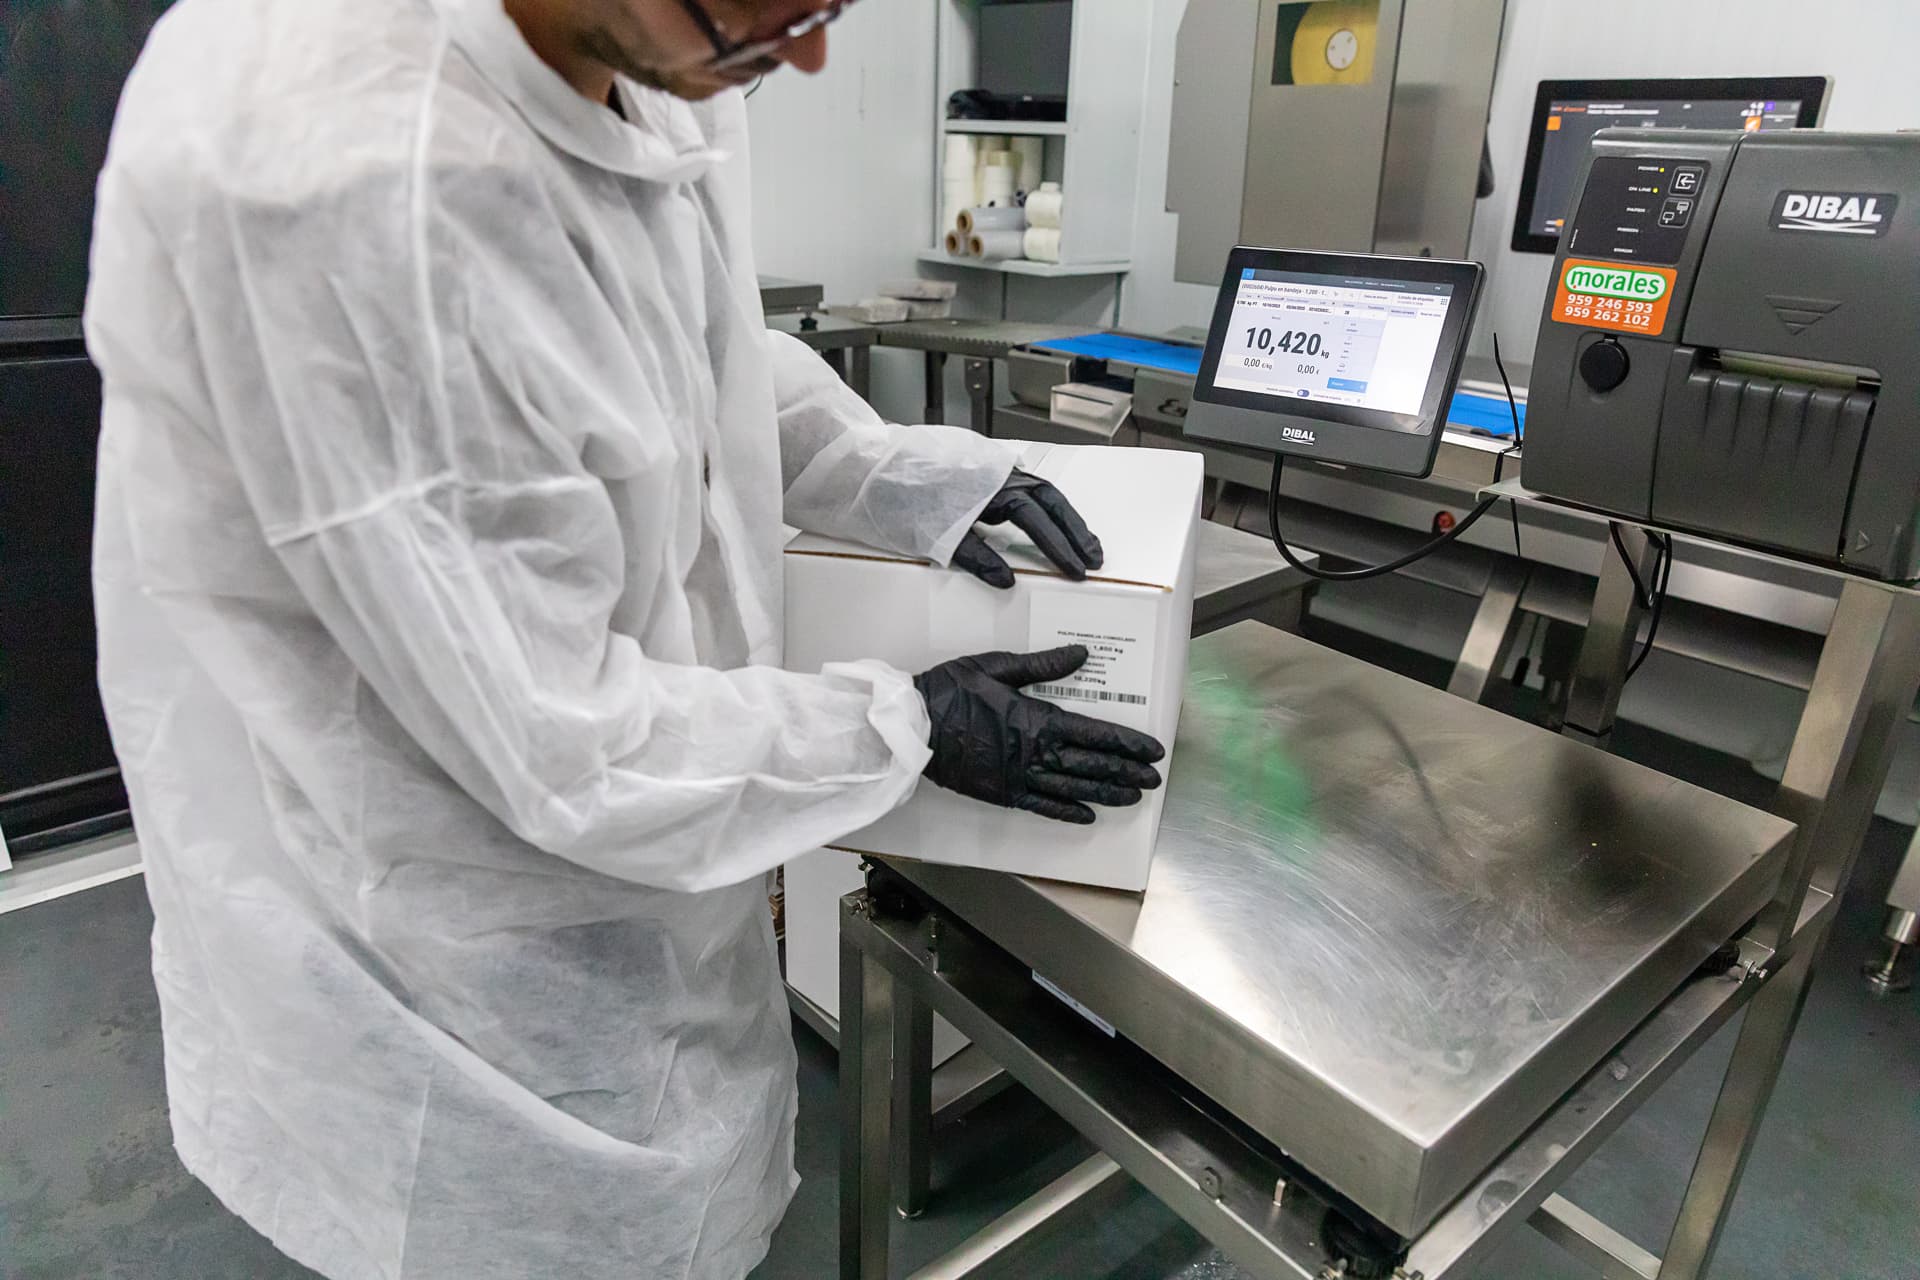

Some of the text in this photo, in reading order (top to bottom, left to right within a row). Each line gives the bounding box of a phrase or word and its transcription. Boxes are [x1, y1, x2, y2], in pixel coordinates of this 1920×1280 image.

[1782, 194, 1882, 223] DIBAL
[1570, 271, 1660, 295] morales
[1567, 294, 1653, 314] 959 246 593
[1565, 306, 1650, 327] 959 262 102
[1246, 327, 1322, 356] 10,420
[1321, 349, 1330, 359] kg
[1243, 357, 1261, 368] 0,00
[1297, 364, 1315, 375] 0,00
[1282, 427, 1316, 441] DIBAL
